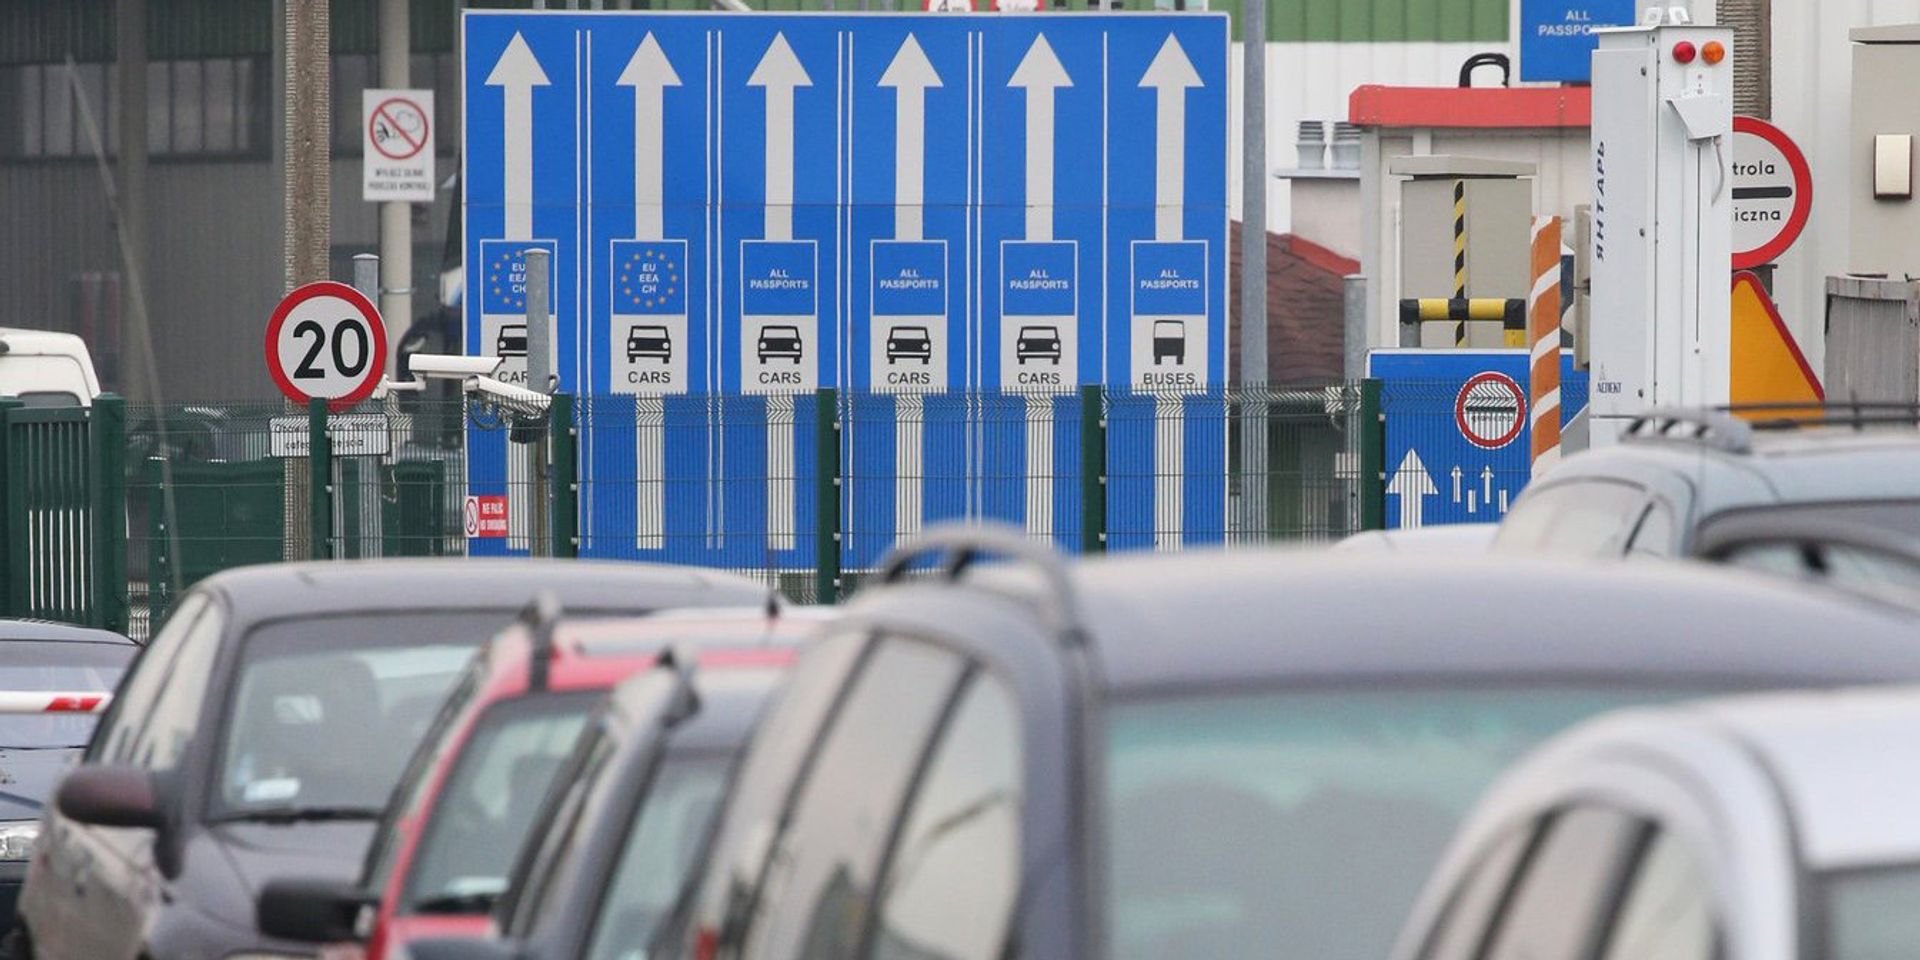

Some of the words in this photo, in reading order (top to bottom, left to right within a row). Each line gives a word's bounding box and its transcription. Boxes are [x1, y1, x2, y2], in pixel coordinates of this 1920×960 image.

[1565, 10, 1591, 21] ALL
[1538, 24, 1617, 37] PASSPO
[1732, 160, 1775, 176] trola
[1734, 206, 1781, 222] iczna
[512, 262, 526, 271] EU
[642, 262, 657, 272] EU
[640, 273, 659, 283] EEA
[770, 268, 789, 279] ALL
[899, 268, 919, 279] ALL
[1029, 269, 1049, 279] ALL
[1160, 269, 1179, 279] ALL
[642, 285, 657, 294] CH
[750, 279, 809, 290] PASSPORTS
[879, 279, 939, 290] PASSPORTS
[1009, 280, 1069, 290] PASSPORTS
[1140, 280, 1199, 290] PASSPORTS
[293, 318, 369, 379] 20
[498, 370, 529, 383] CAR
[627, 370, 671, 384] CARS
[759, 371, 802, 385] CARS
[887, 371, 931, 385] CARS
[1017, 372, 1061, 385] CARS
[1143, 372, 1196, 385] BUSES
